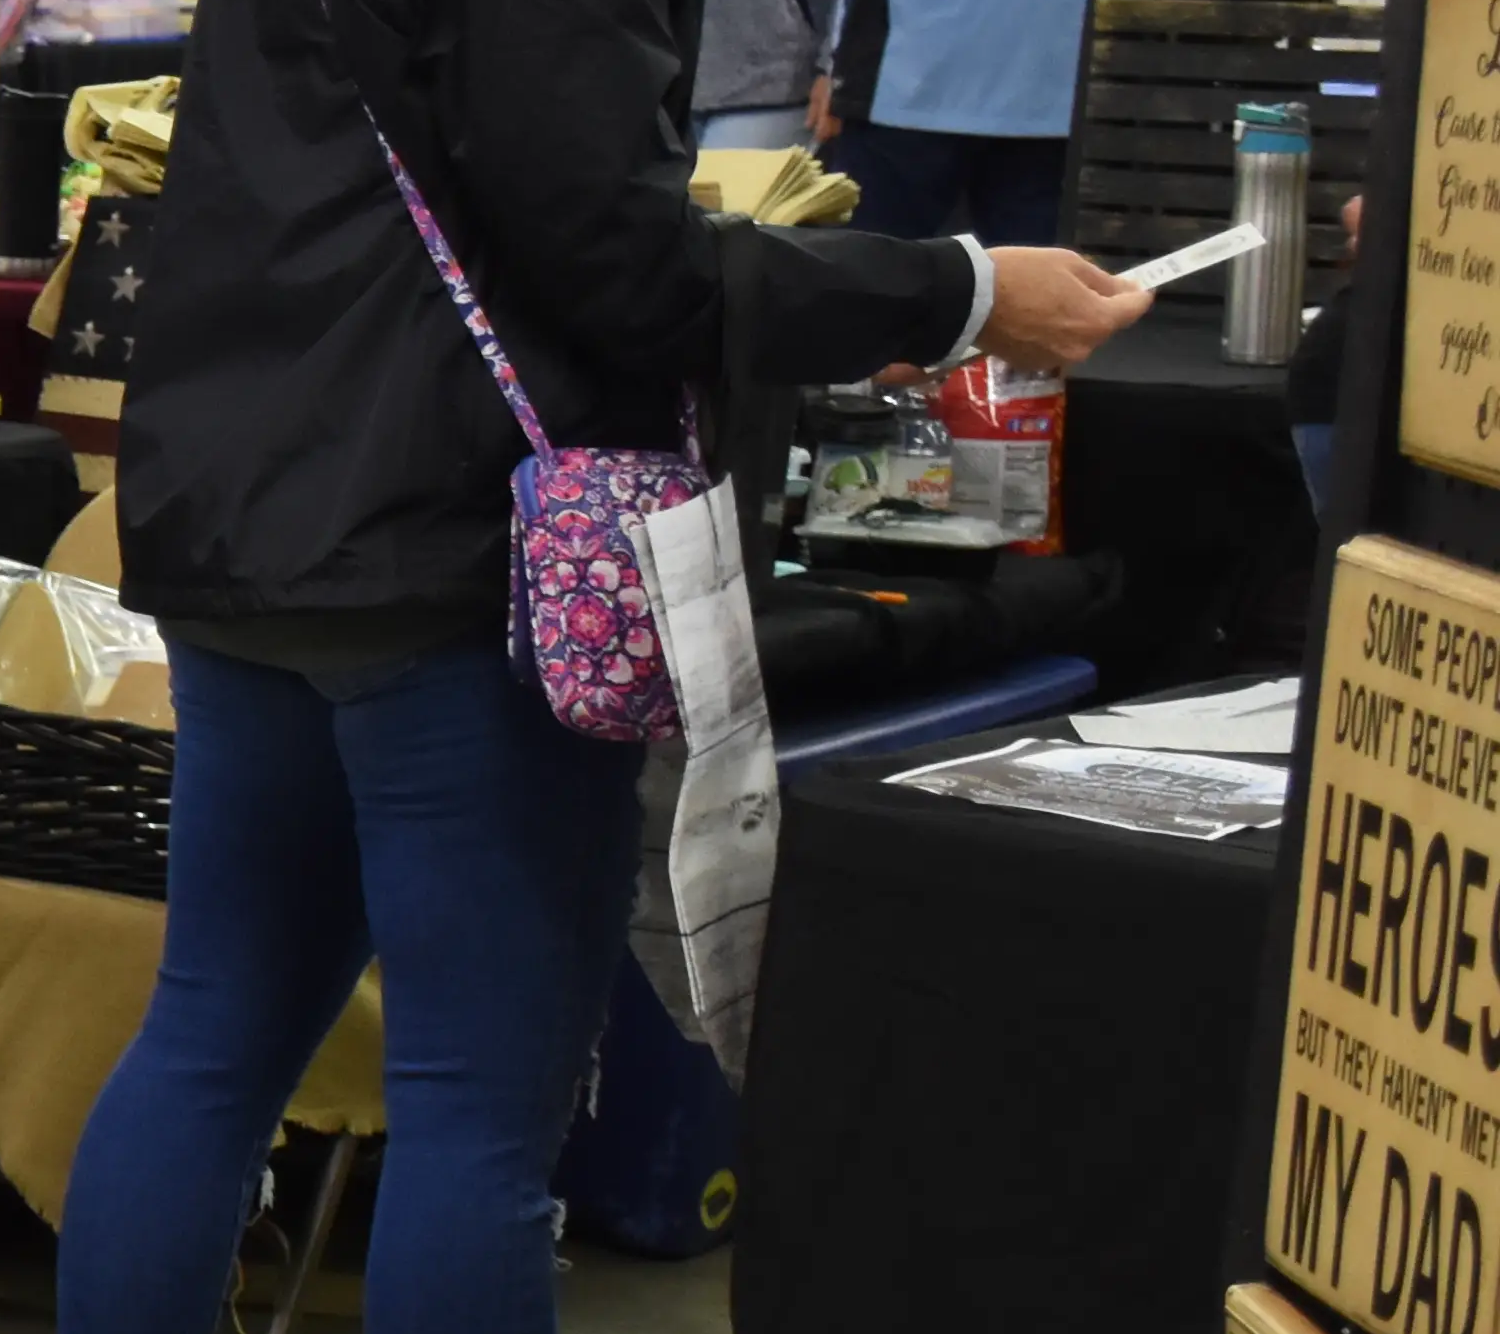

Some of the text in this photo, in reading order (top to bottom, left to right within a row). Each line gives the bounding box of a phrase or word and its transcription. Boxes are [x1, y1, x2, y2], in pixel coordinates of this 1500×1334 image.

[1461, 246, 1494, 287] love
[1362, 592, 1431, 679] SOME
[1333, 677, 1499, 812] DON'T BELIEVE
[1295, 1008, 1331, 1070] BUT
[1333, 1028, 1378, 1096] THEY
[1381, 1056, 1459, 1138] HAVEN'T
[1280, 1090, 1368, 1292] MY
